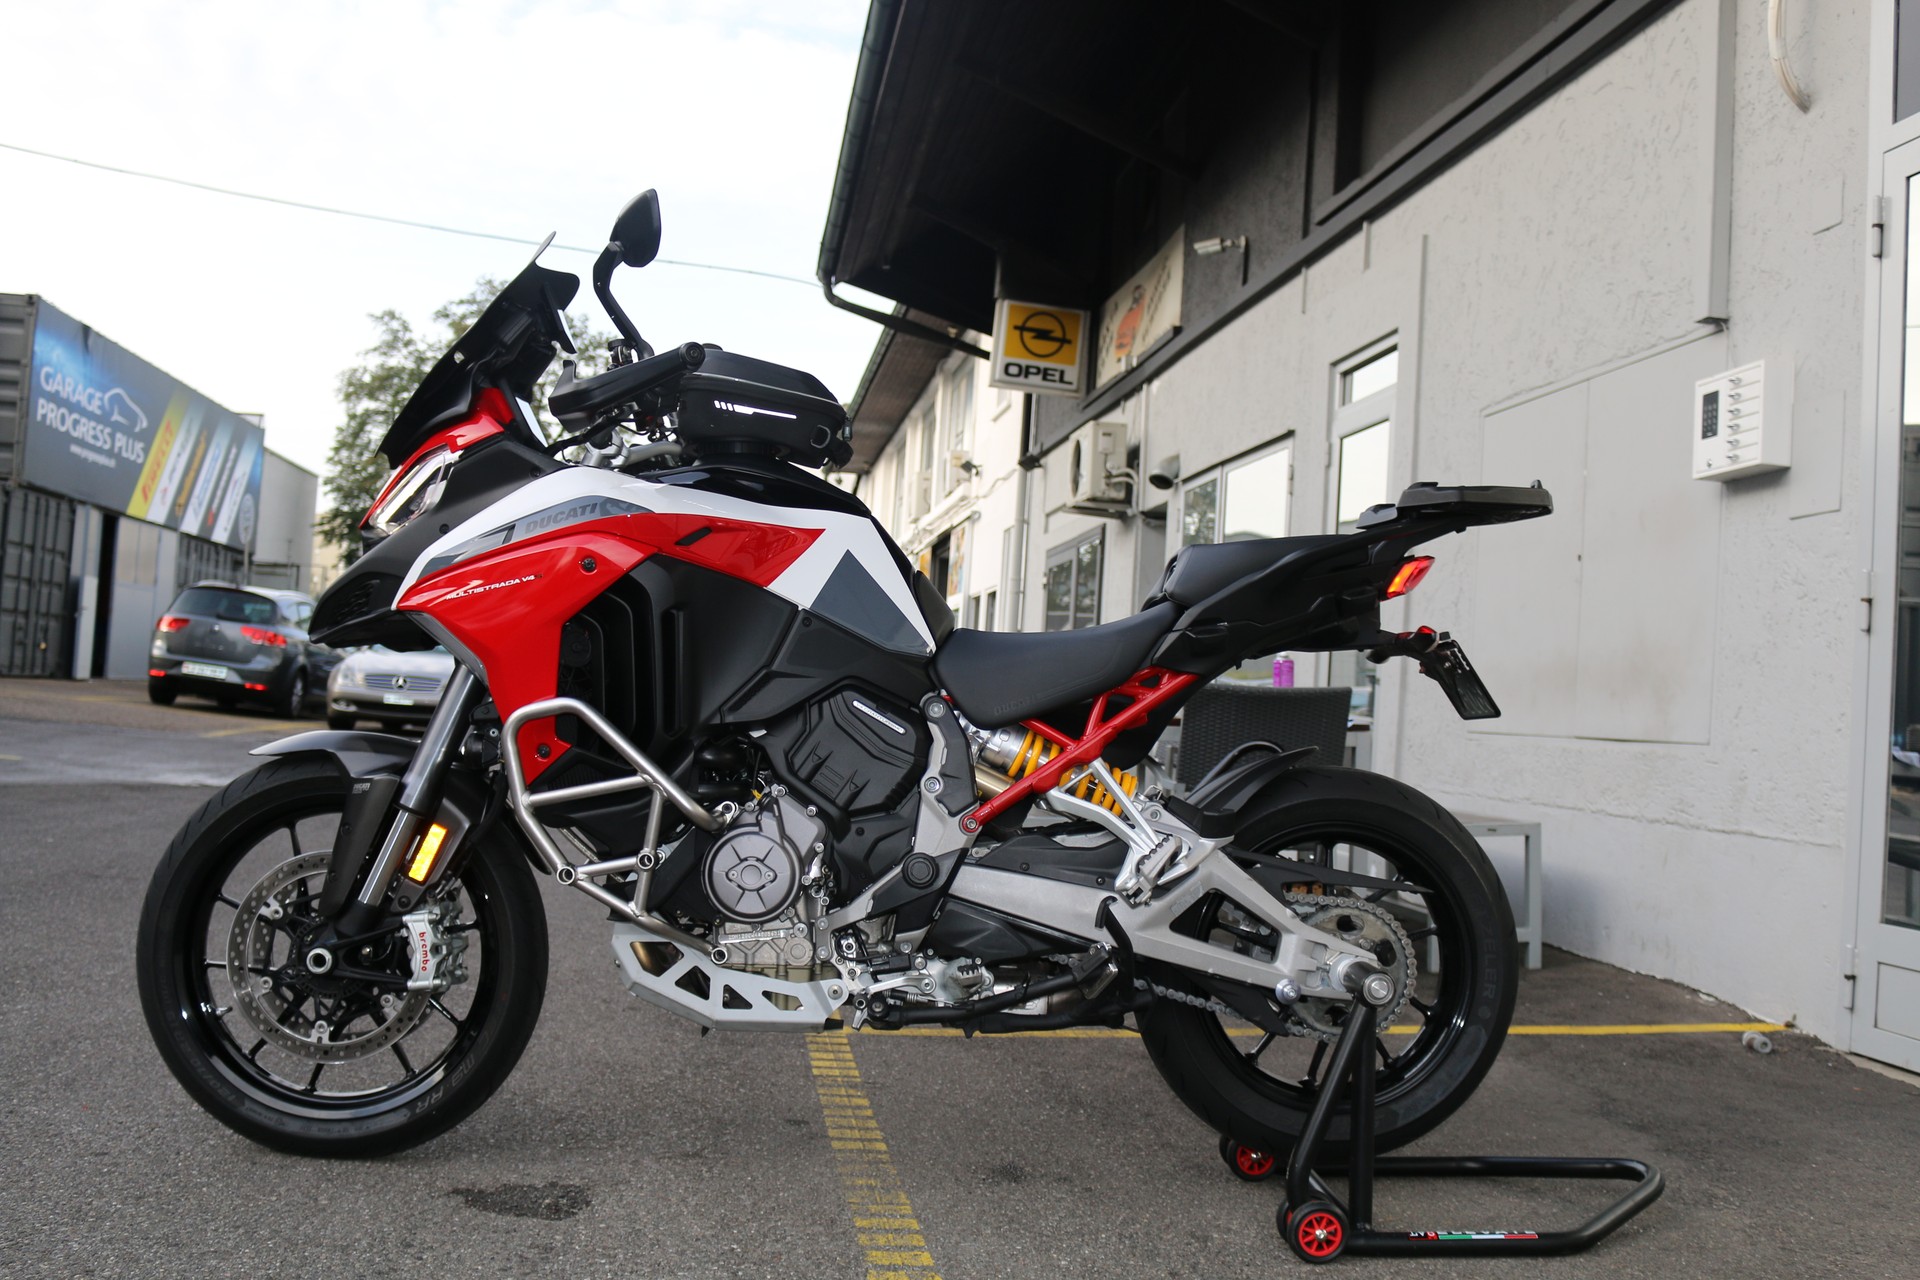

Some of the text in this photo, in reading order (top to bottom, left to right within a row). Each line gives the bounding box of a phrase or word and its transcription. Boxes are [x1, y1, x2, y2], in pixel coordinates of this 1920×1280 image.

[41, 367, 103, 415] GARAGE
[1004, 362, 1073, 385] OPEL
[37, 398, 111, 450] PROGRESS
[114, 432, 145, 464] PLUS
[525, 502, 598, 534] DUCATI
[446, 579, 521, 600] MULTISTRADA
[418, 931, 430, 972] brembo
